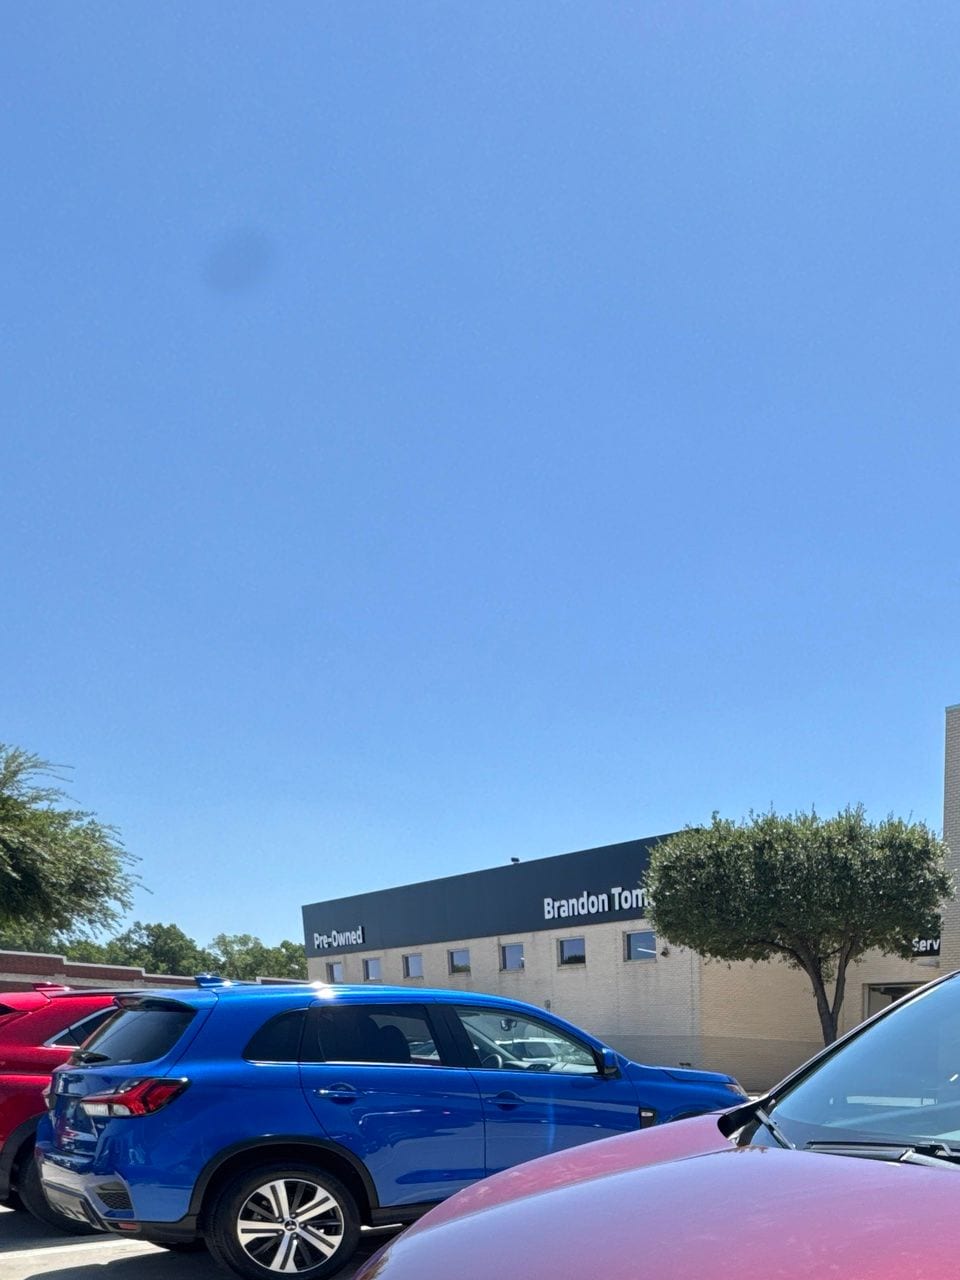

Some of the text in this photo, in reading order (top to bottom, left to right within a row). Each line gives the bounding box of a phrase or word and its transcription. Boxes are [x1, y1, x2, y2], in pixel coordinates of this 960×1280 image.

[543, 886, 653, 920] Brandon Tom
[313, 925, 363, 949] Pre-Owned
[911, 937, 940, 951] Serv
